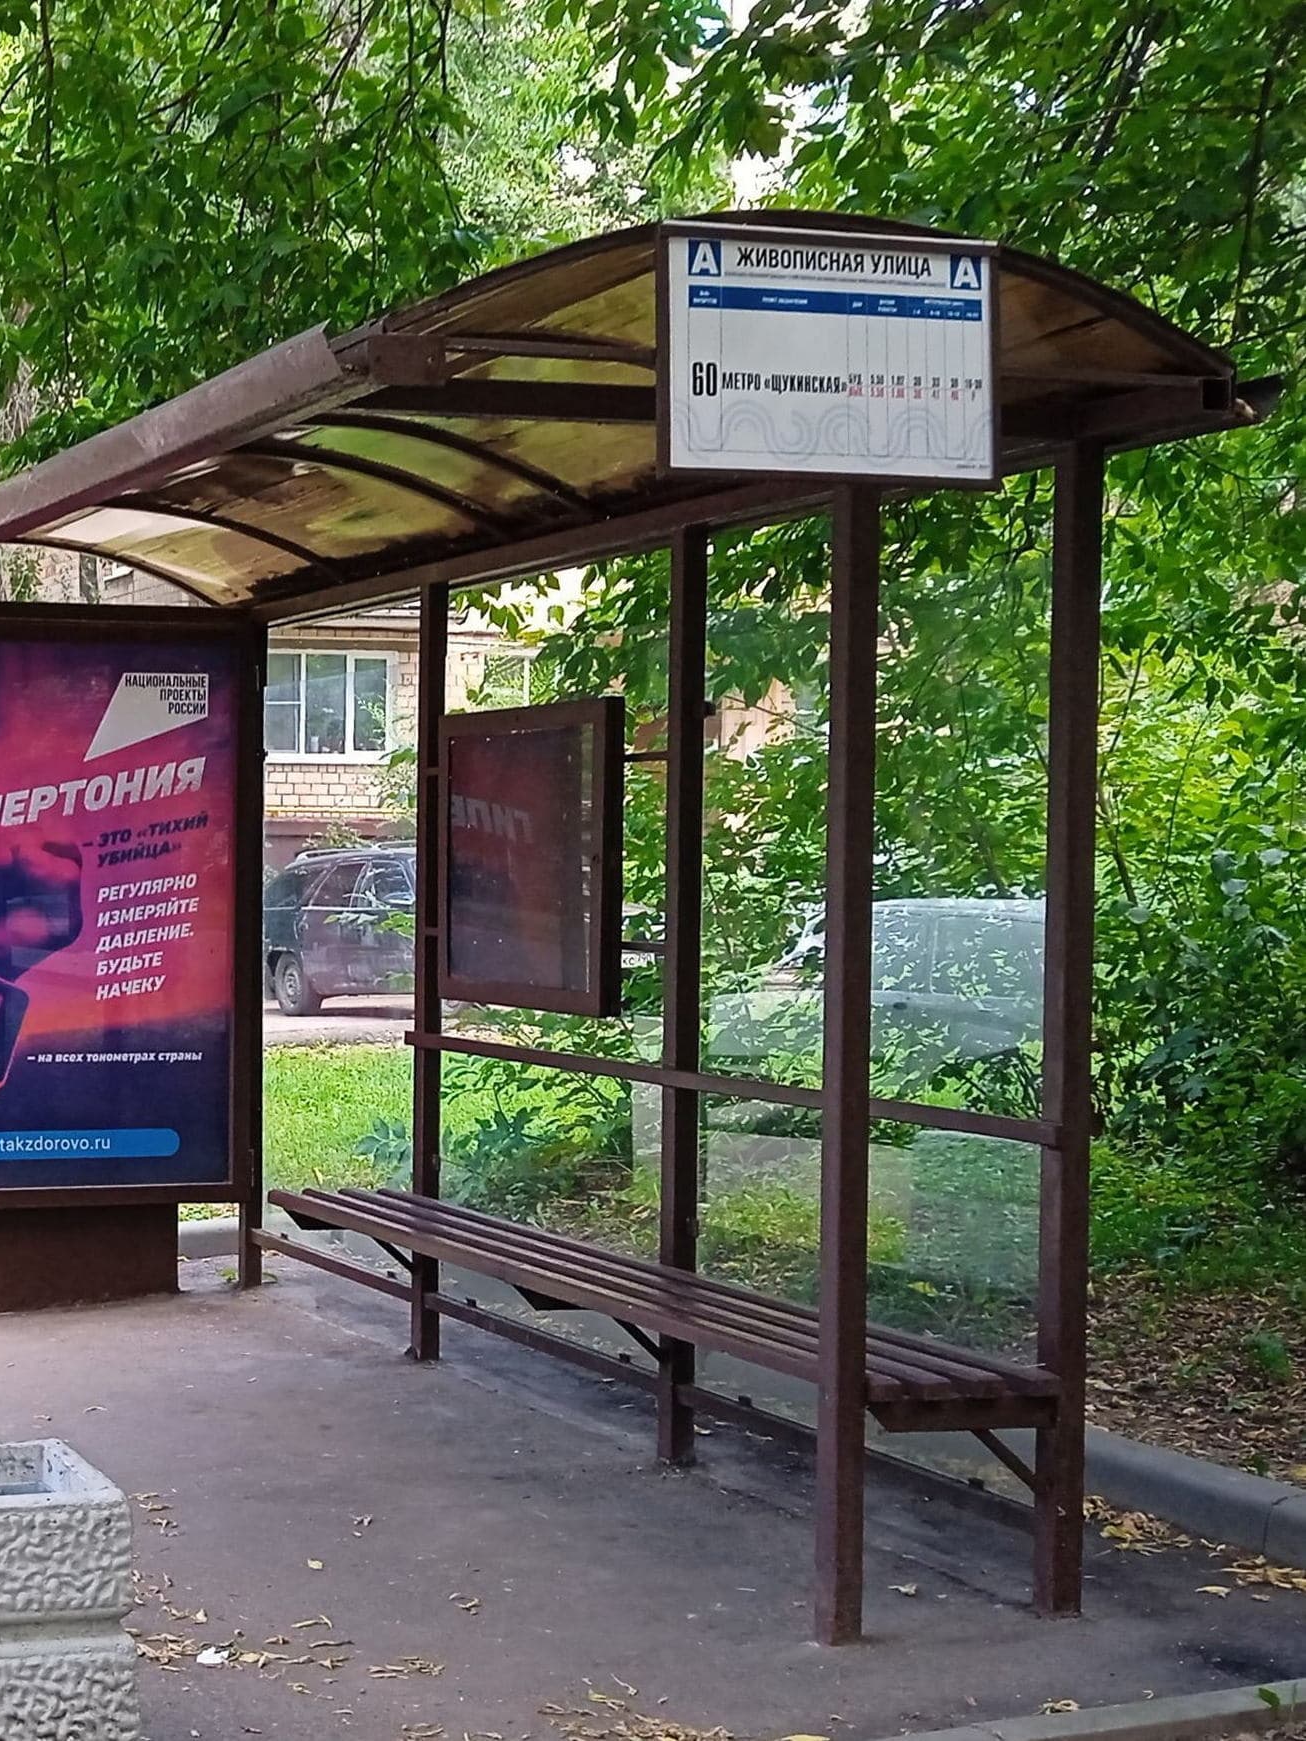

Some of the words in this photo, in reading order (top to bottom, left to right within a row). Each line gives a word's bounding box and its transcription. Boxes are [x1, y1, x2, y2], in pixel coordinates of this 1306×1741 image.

[736, 246, 865, 274] ЖИВОПИСНАЯ
[871, 254, 932, 279] УЛИЦА
[692, 362, 718, 397] 60
[721, 372, 761, 391] МЕТРО
[764, 374, 847, 394] «ЩУКИНСКАЯ»
[124, 674, 207, 688] НАЦИОНАЛЬНЫЕ
[159, 688, 207, 701] ПРОЕКТЫ
[168, 702, 206, 715] РОССИИ
[98, 828, 132, 847] ЭТО
[136, 810, 209, 838] «ТИХИЙ
[97, 841, 182, 868] УБИЙЦА»
[97, 873, 197, 903] РЕГУЛЯРНО
[96, 897, 200, 928] ИЗМЕРЯЙТЕ
[95, 922, 194, 954] ДАВЛЕНИЕ.
[96, 951, 163, 976] БУДЬТЕ
[95, 975, 166, 1001] НАЧЕКУ
[38, 1053, 52, 1063] на
[55, 1053, 83, 1063] всех
[86, 1052, 155, 1064] тонометрах
[158, 1051, 202, 1064] страны
[0, 1135, 111, 1152] takzdorovo.ru
